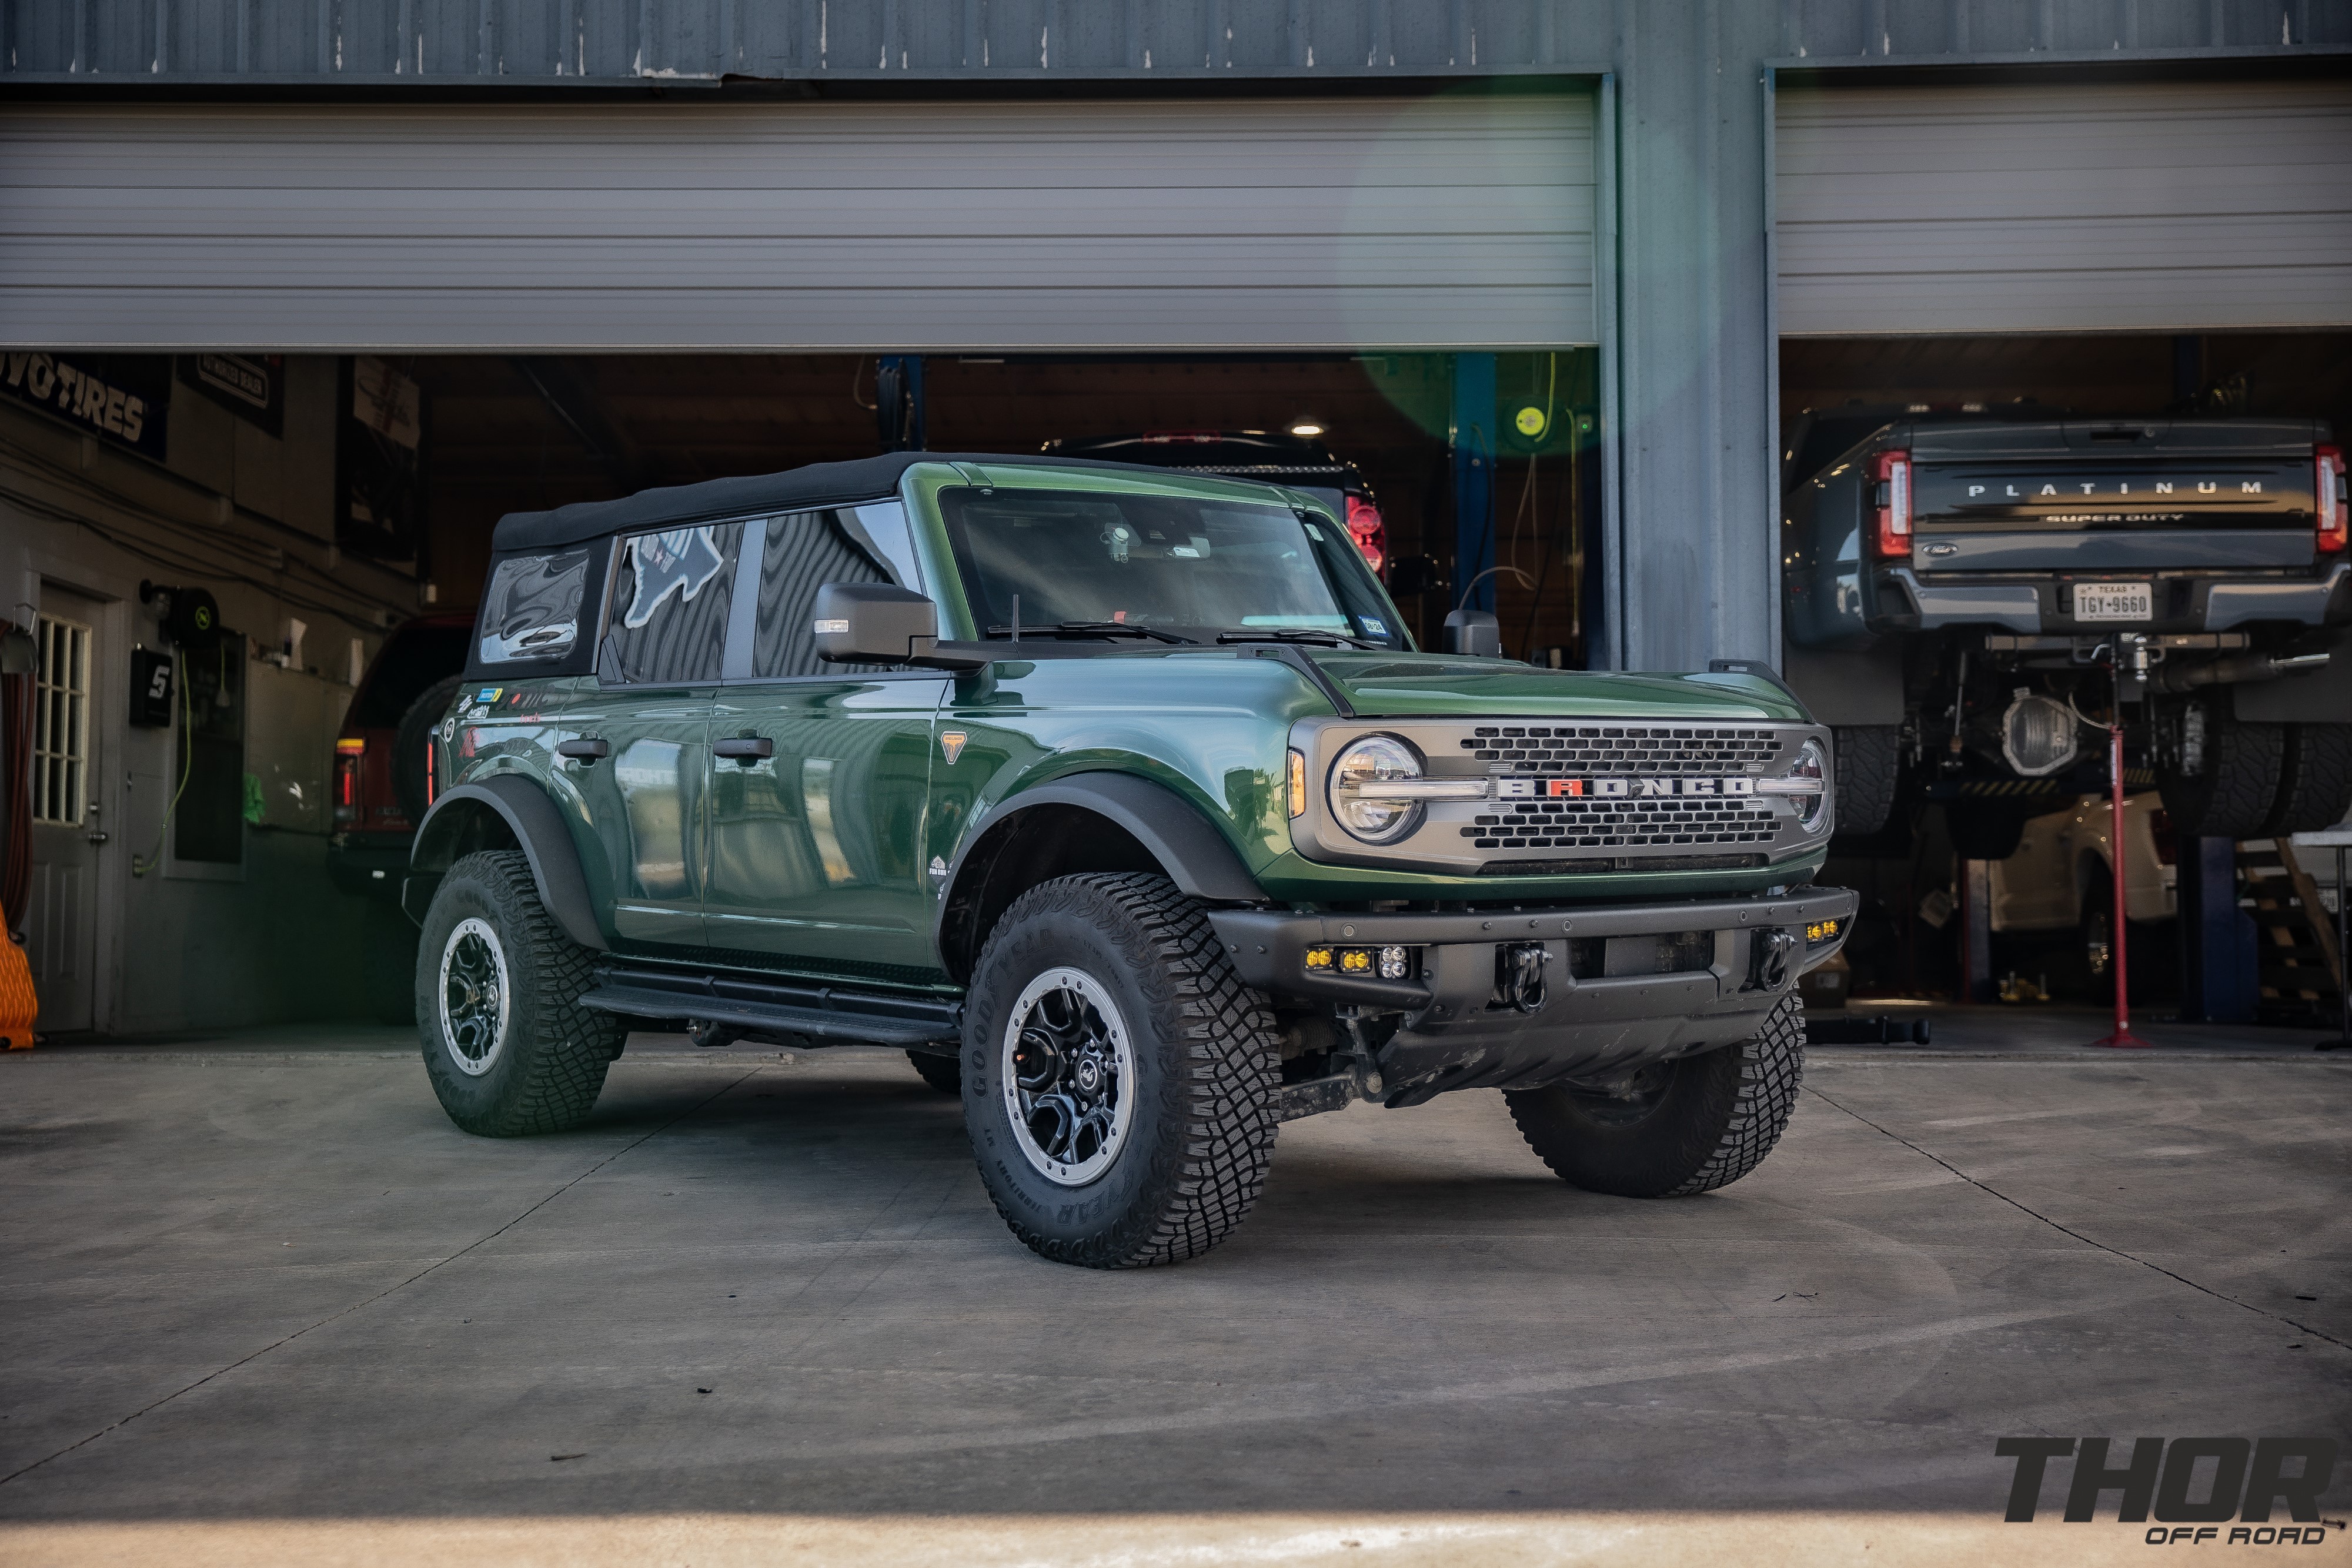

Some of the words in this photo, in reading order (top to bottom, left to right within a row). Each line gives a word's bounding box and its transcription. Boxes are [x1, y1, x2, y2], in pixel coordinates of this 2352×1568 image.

[57, 360, 144, 442] TIRES
[1969, 481, 2262, 497] PLATINUM
[2046, 514, 2122, 523] SUPER
[1498, 778, 1753, 798] BRONCO
[995, 1159, 1042, 1212] TERRITORY
